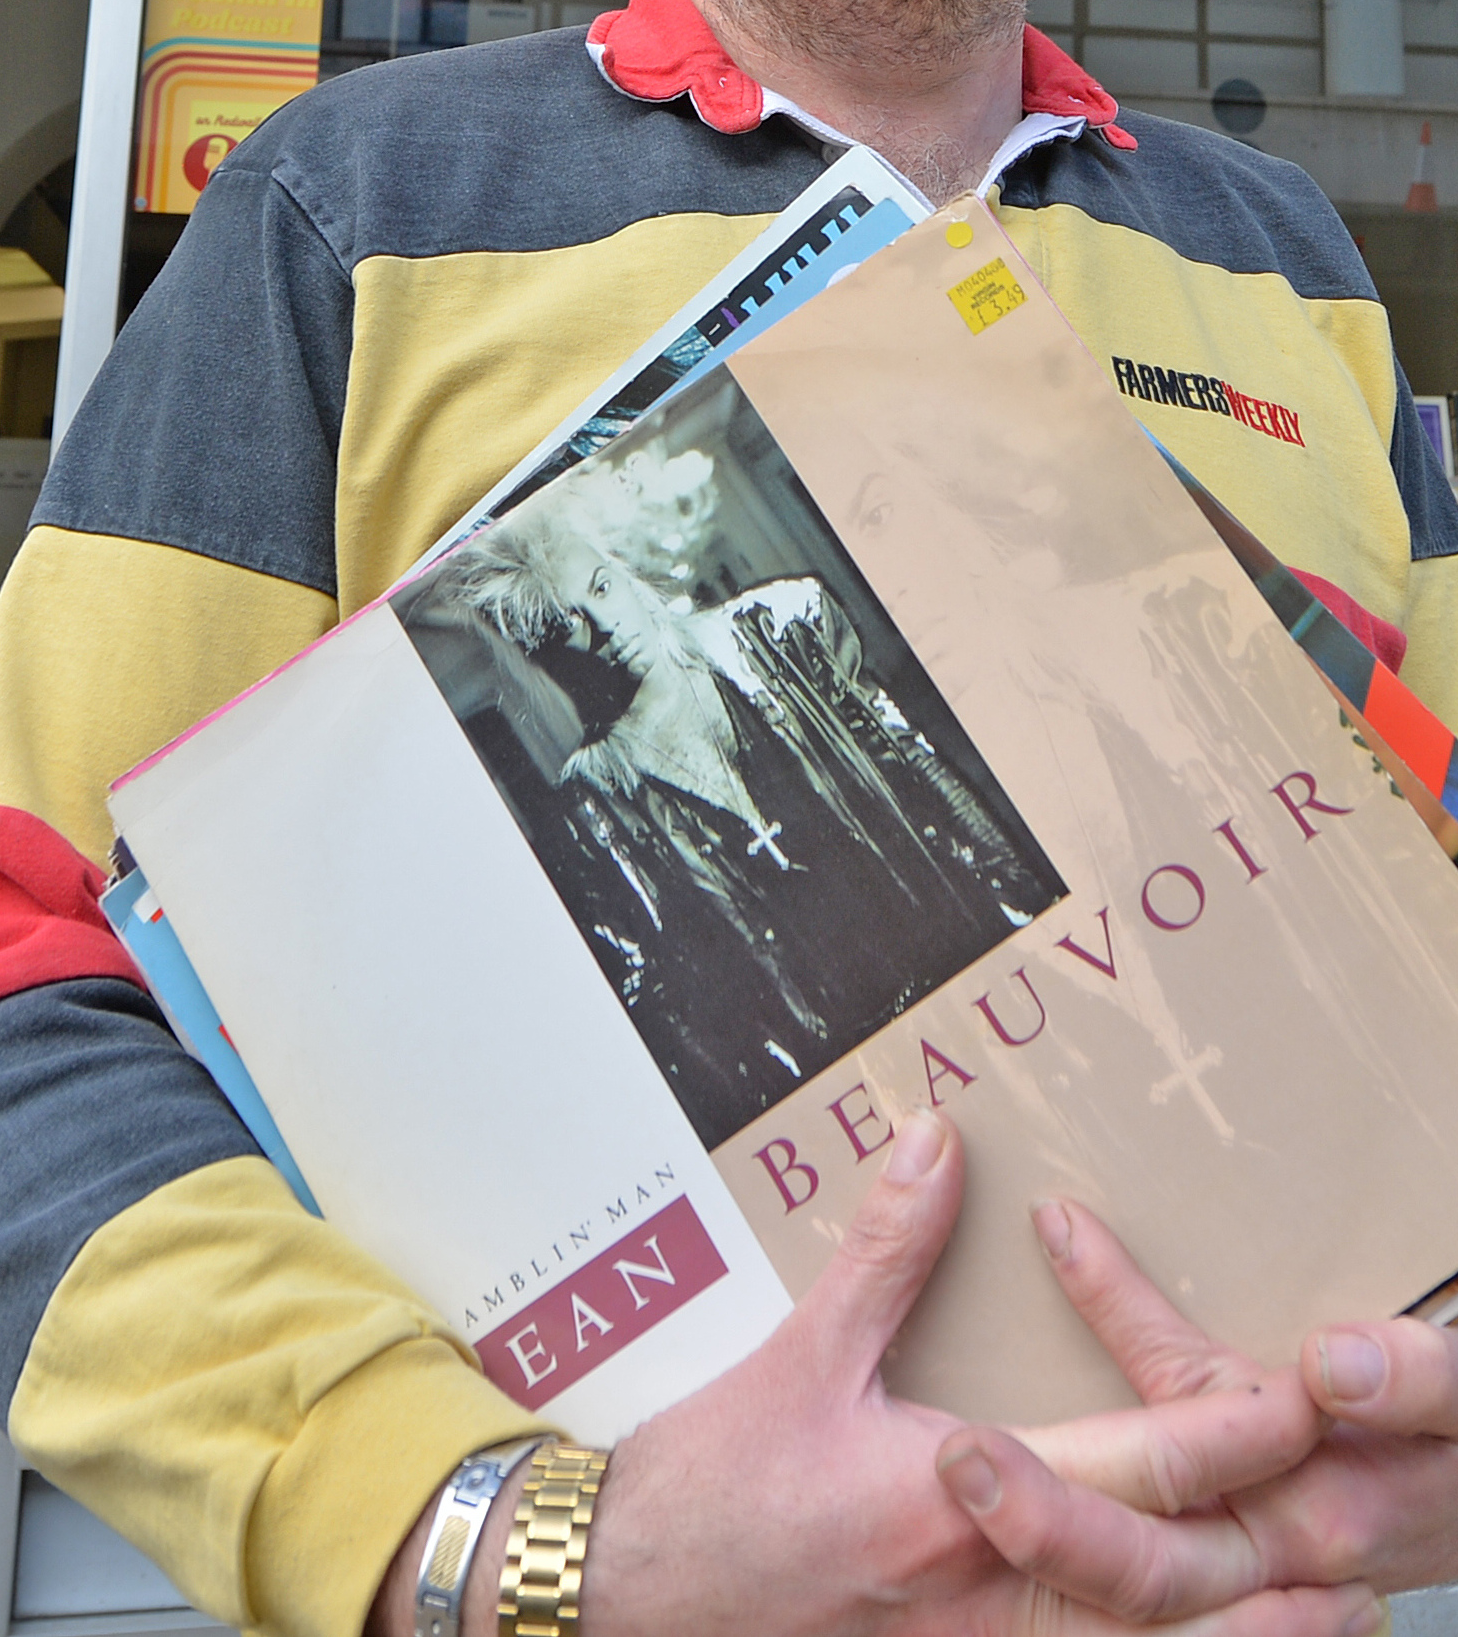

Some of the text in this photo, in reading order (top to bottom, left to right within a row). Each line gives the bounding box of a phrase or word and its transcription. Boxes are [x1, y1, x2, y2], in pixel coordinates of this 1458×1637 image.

[170, 8, 294, 36] Podcast
[751, 771, 1355, 1215] BEAUVOIR
[462, 1163, 675, 1329] AMBLIN' MAN
[504, 1234, 677, 1390] EAN
